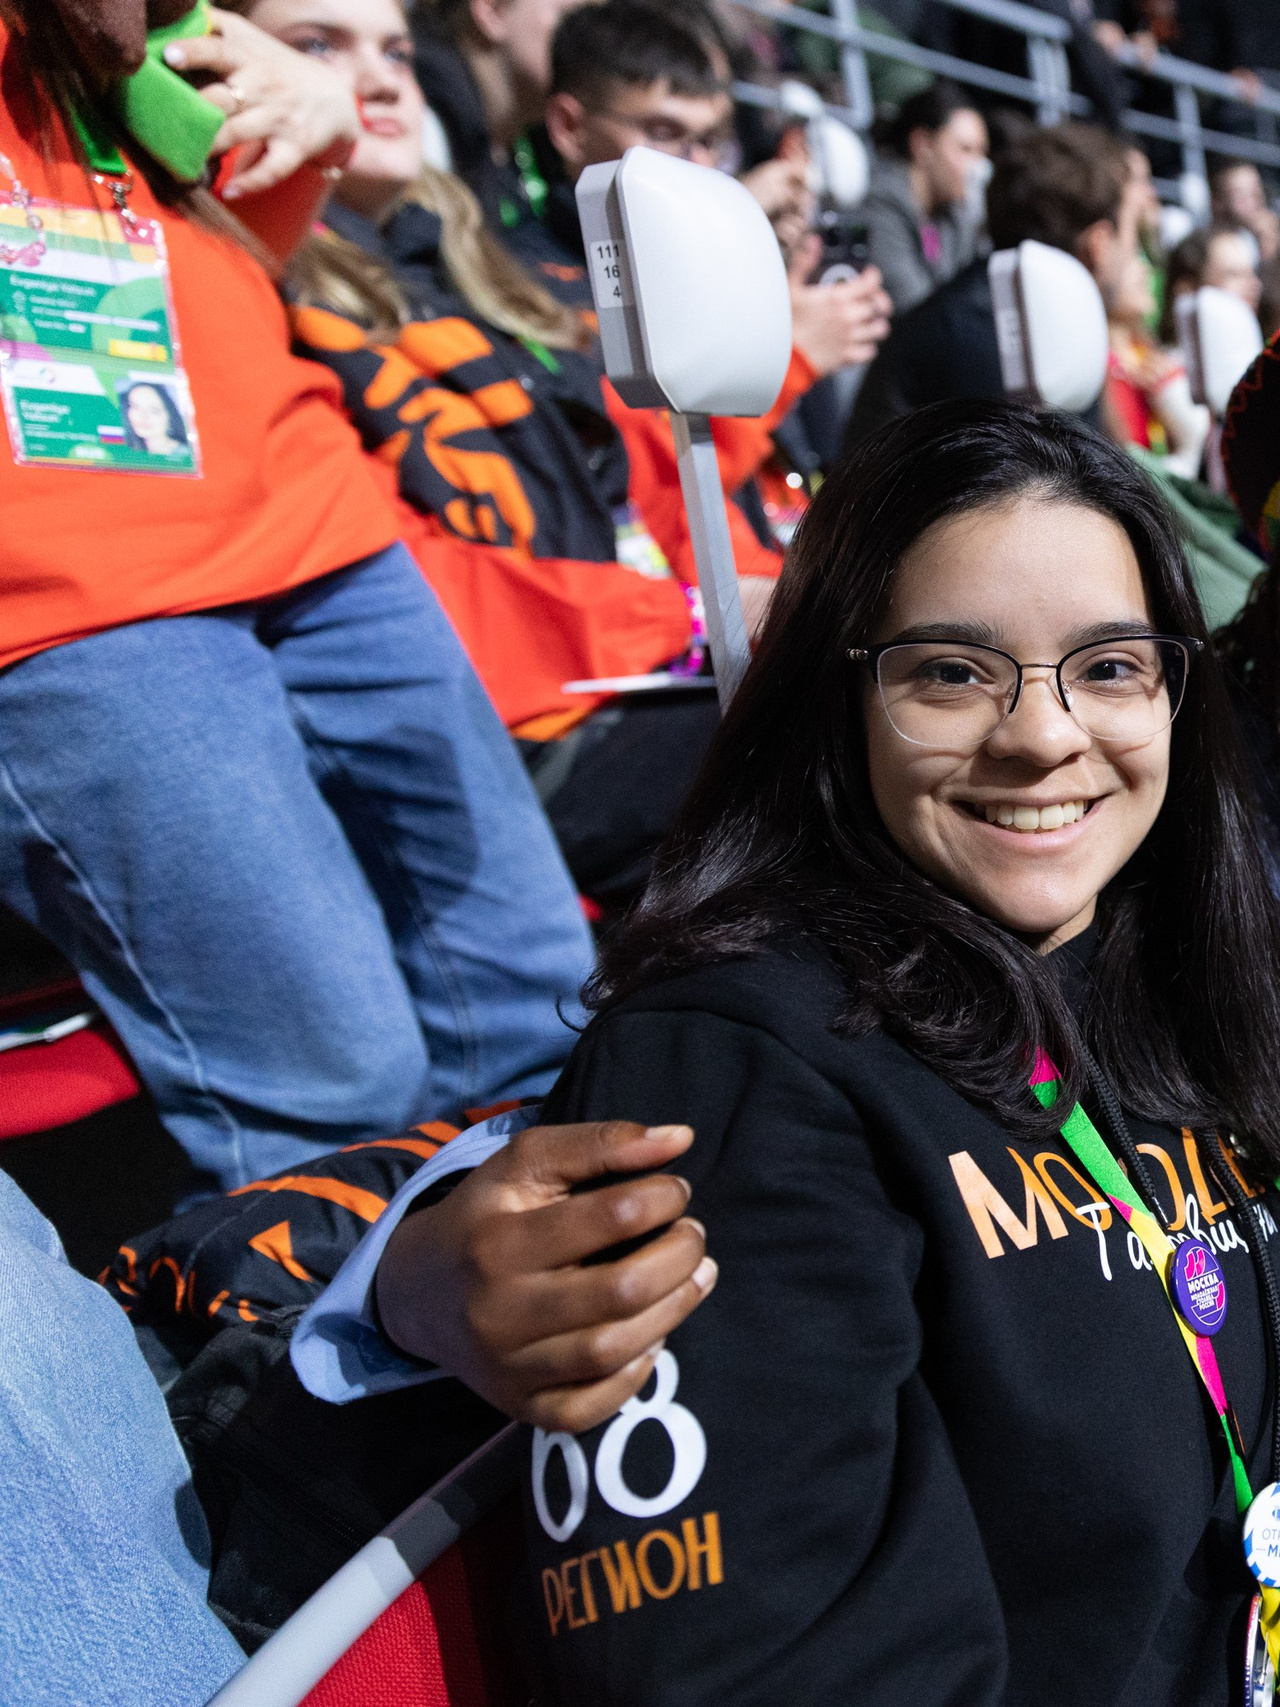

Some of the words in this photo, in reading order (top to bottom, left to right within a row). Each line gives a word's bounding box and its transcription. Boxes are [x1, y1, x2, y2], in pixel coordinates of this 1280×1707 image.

[596, 244, 620, 258] 111
[604, 265, 620, 278] 16
[613, 286, 621, 297] 4
[1187, 1273, 1219, 1293] МОСКВА
[531, 1348, 707, 1543] 68
[542, 1511, 724, 1636] РЕГИОН
